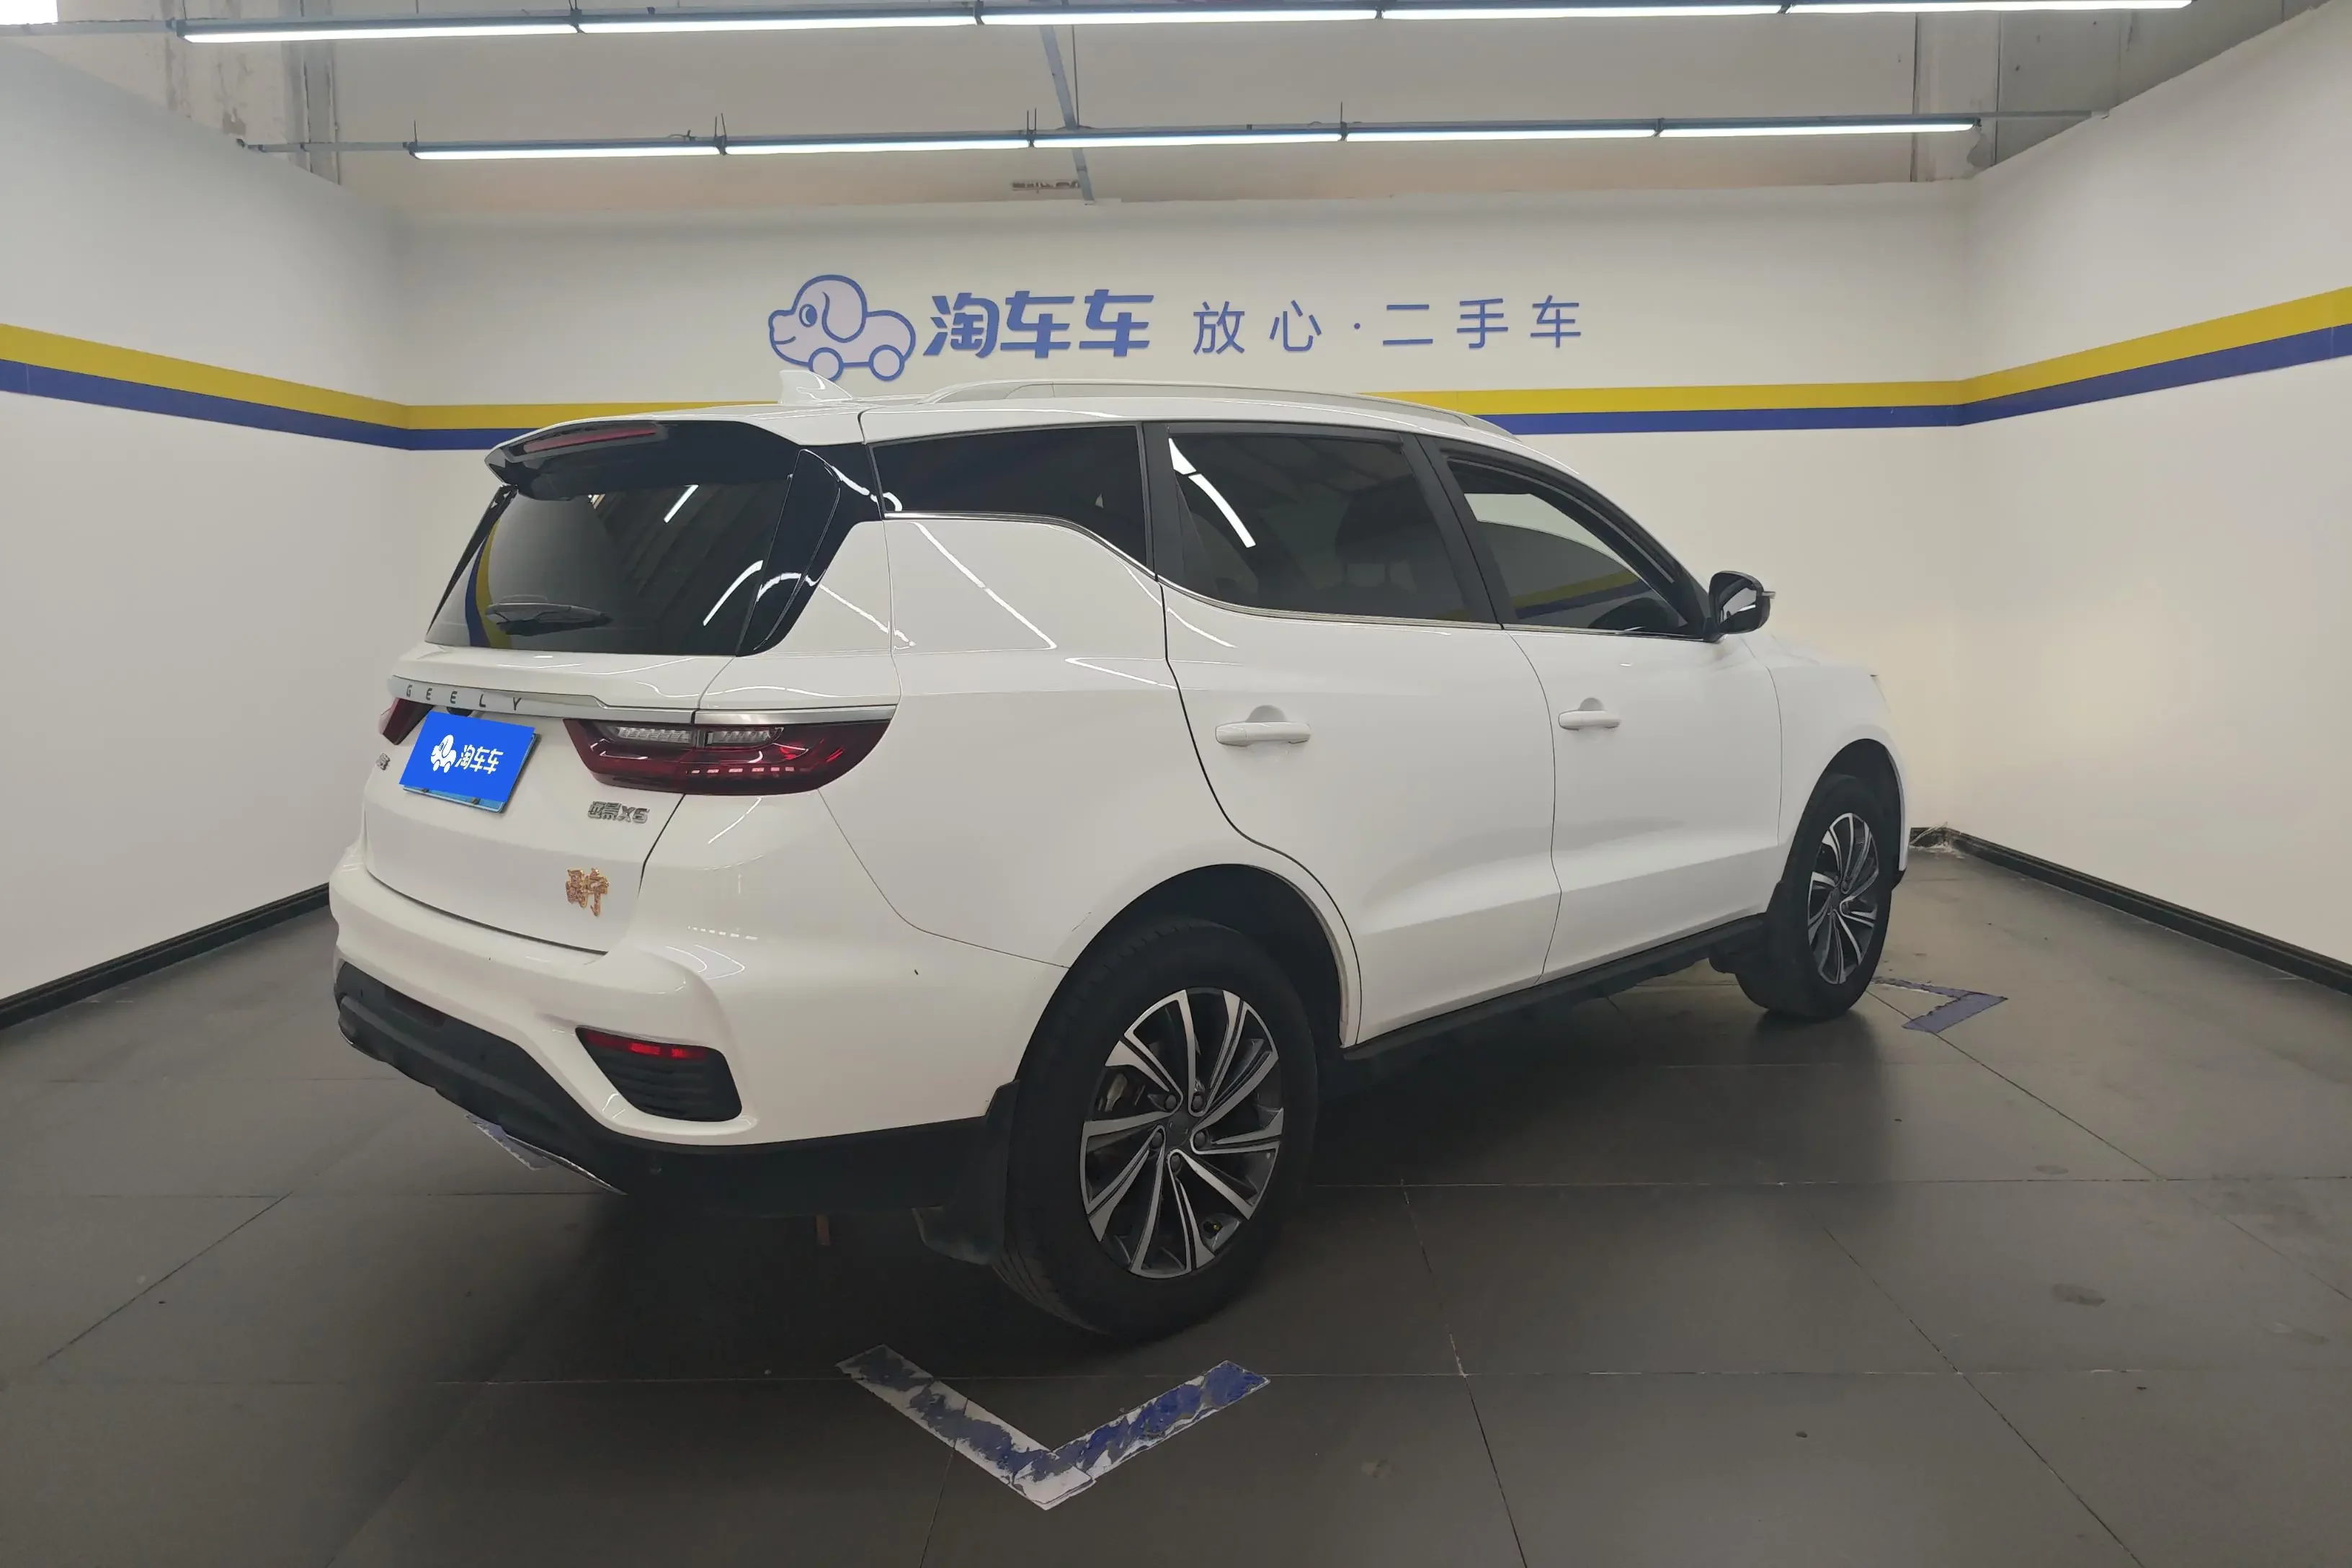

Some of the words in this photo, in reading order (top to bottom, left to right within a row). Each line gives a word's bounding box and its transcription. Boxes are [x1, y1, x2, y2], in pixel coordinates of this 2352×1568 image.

[922, 289, 1154, 358] 淘车车
[406, 684, 522, 711] GEELY
